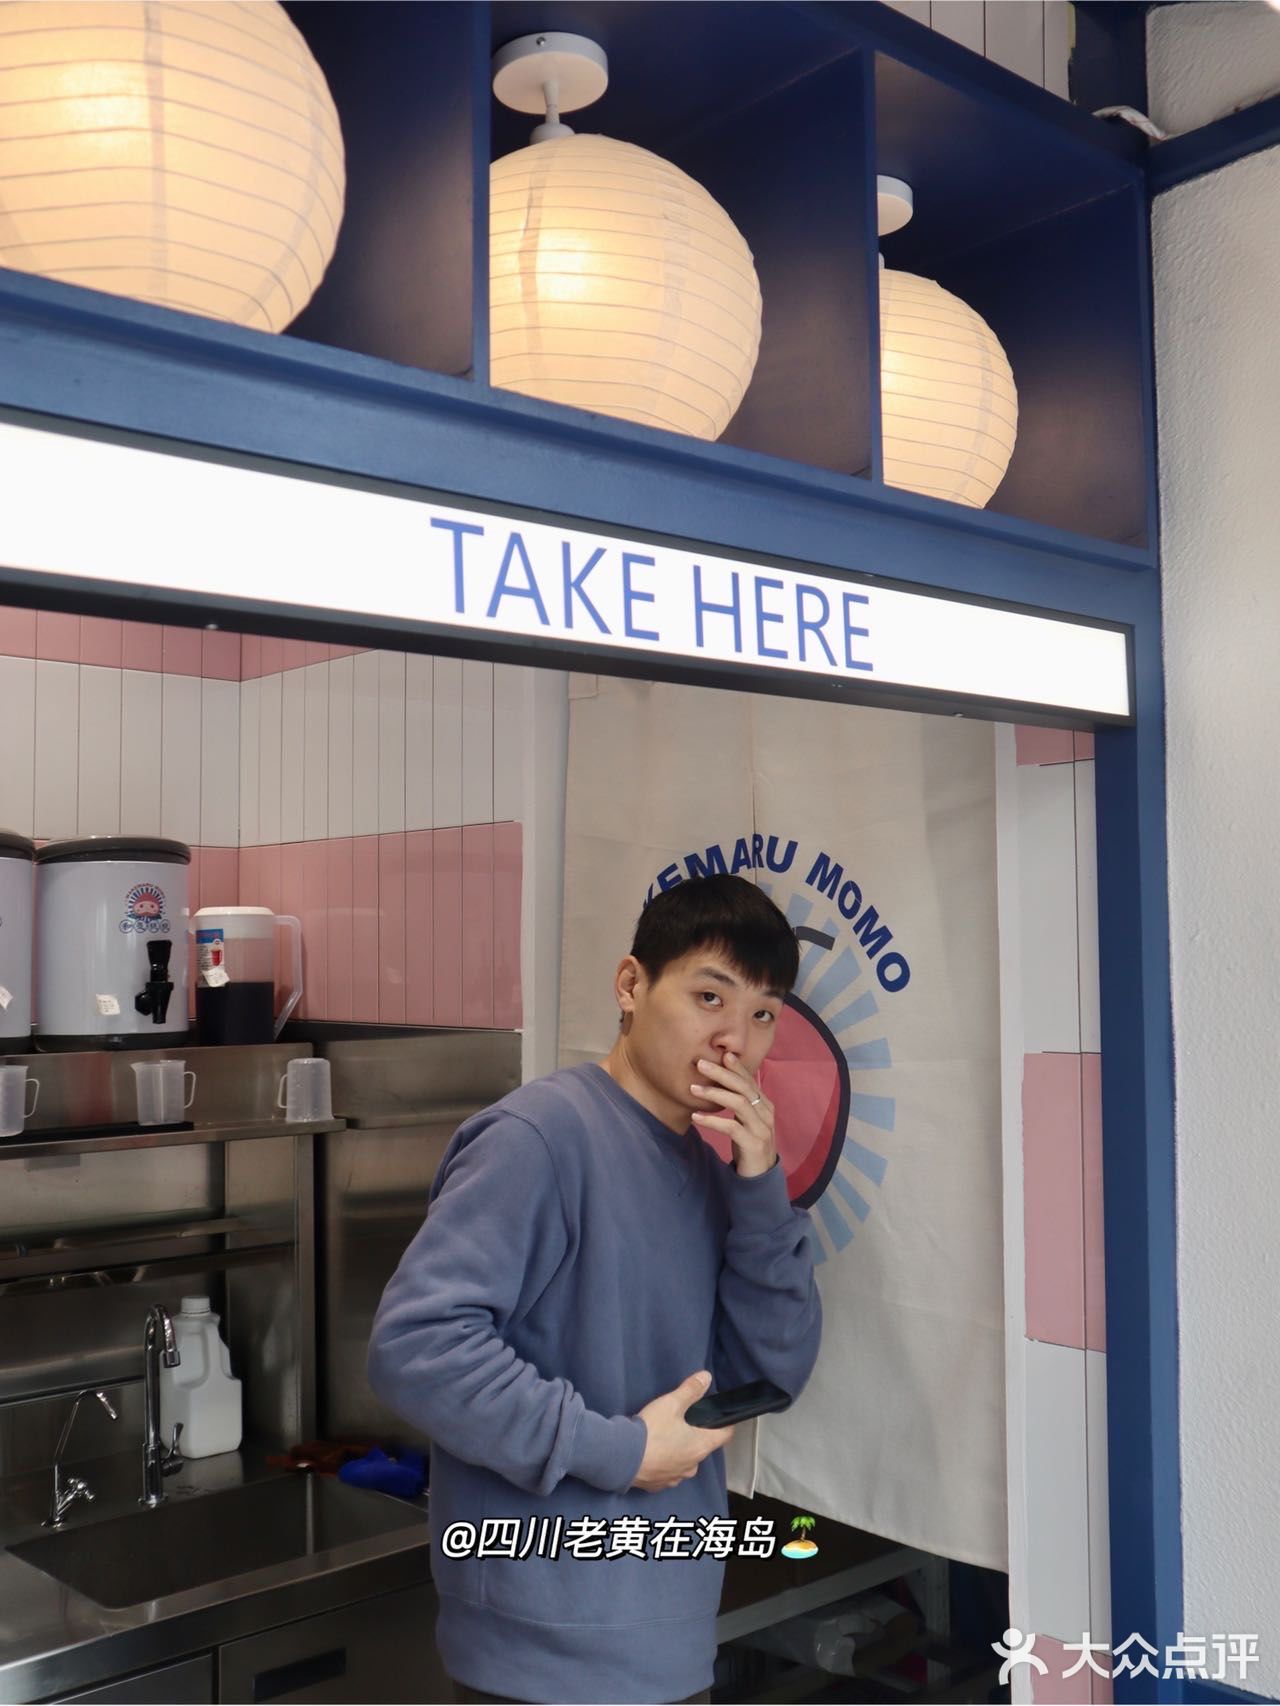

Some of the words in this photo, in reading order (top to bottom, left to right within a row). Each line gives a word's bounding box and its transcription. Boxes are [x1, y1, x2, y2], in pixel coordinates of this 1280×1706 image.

[430, 517, 659, 642] TAKE
[693, 565, 874, 672] HERE
[805, 851, 911, 993] MOMO
